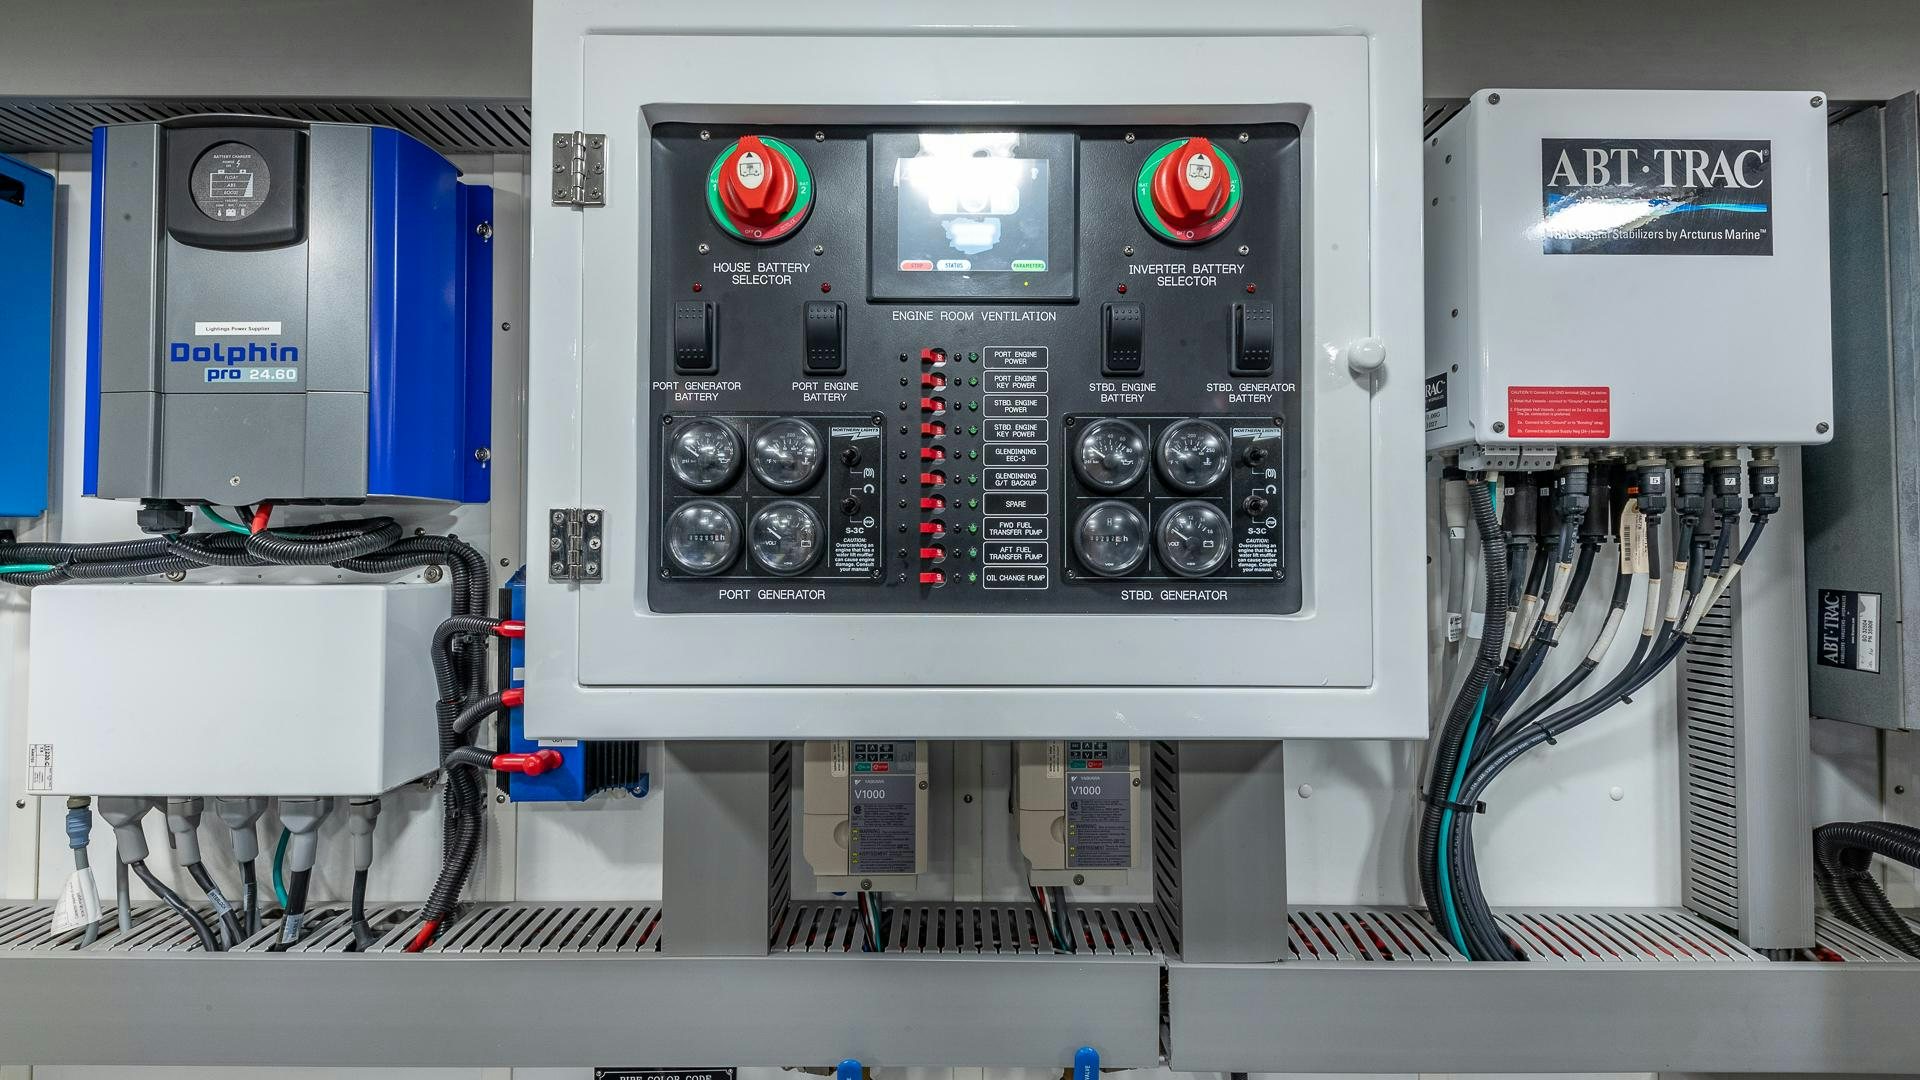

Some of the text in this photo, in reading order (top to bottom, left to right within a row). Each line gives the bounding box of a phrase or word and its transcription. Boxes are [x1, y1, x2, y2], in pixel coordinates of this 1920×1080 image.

[1612, 228, 1664, 240] Stabilizers
[1665, 229, 1677, 241] by
[1679, 230, 1723, 240] Arcturus
[714, 262, 811, 273] HOUSE BATTERY
[1129, 264, 1245, 274] INVERTER BATTERY
[732, 275, 792, 285] SELECTOR
[1157, 276, 1217, 287] SELECTOR
[892, 311, 1057, 321] ENGINE ROOM VENTILATION
[171, 343, 298, 365] Dolphin
[208, 369, 296, 381] pro 24.60
[653, 382, 742, 391] PORT GENERATOR
[792, 382, 859, 391] PORT ENGINE
[1089, 383, 1157, 392] STBD. ENGINE
[1206, 383, 1296, 392] STBD. GENERATOR
[675, 393, 719, 402] BATTERY
[803, 393, 848, 402] BATTERY
[1101, 394, 1145, 403] BATTERY
[1229, 394, 1273, 403] BATTERY
[1014, 423, 1038, 431] ENGINE
[995, 472, 1037, 480] GLENDINNING
[1005, 500, 1027, 508] SPARE
[989, 528, 1043, 536] TRANSFER PUMP
[719, 590, 826, 600] PORT GENERATOR
[1121, 590, 1228, 601] STBD. GENERATOR
[855, 789, 886, 799] V1000
[1071, 786, 1101, 795] V1000
